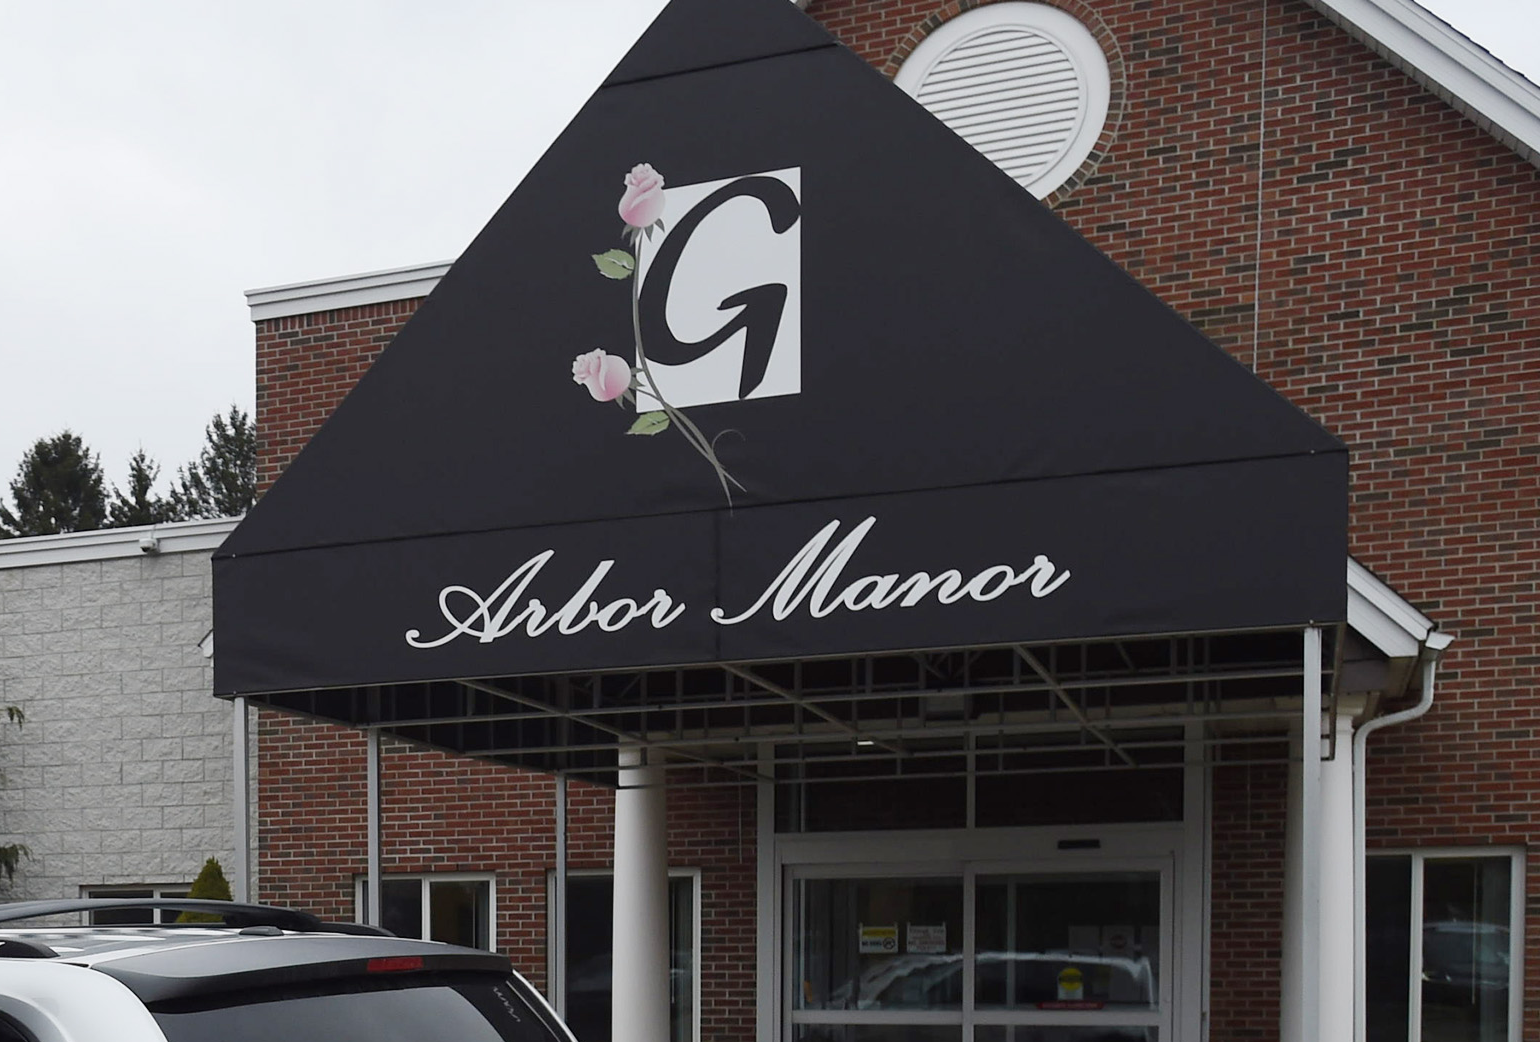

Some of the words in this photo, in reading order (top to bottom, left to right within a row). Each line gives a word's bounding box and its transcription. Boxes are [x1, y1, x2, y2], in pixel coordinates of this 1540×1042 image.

[637, 176, 801, 400] G
[405, 549, 686, 649] Arbor
[710, 515, 1071, 625] Manor
